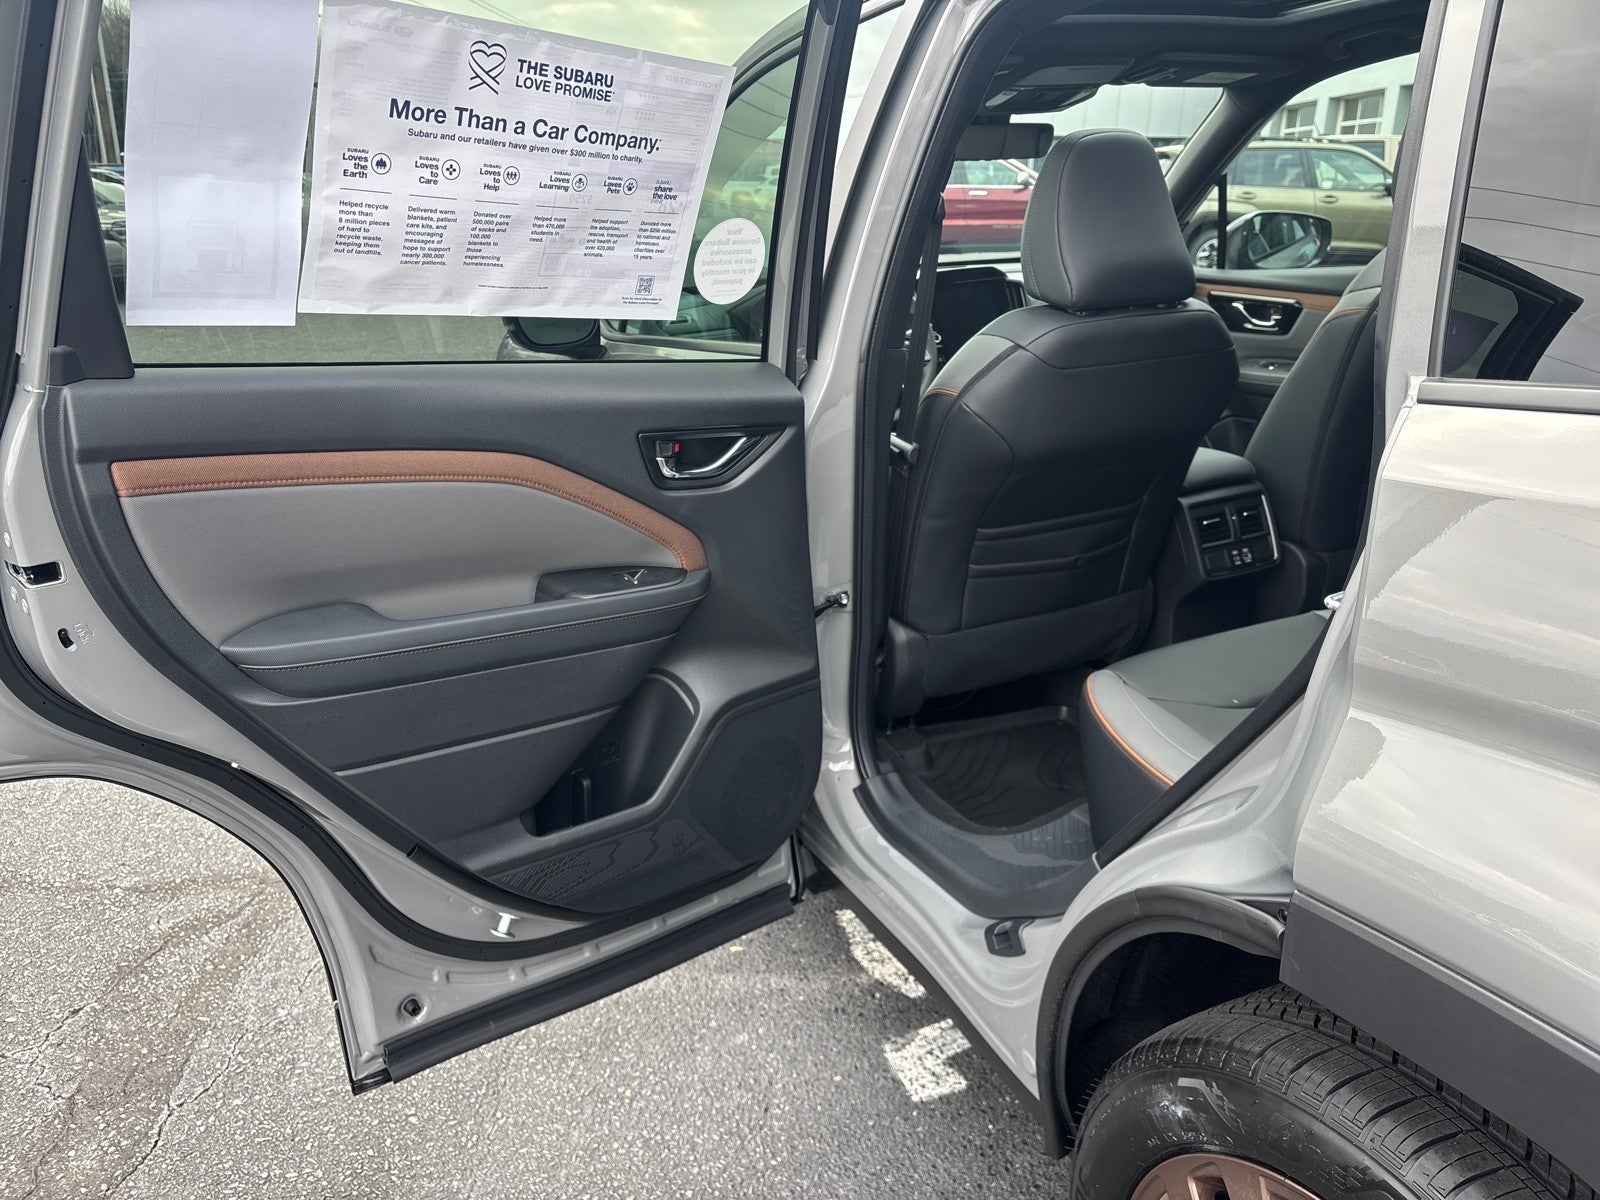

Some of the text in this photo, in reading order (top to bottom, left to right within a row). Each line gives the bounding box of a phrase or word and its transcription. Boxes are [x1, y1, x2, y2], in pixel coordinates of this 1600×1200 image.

[517, 58, 614, 88] THE SUBARU
[515, 75, 552, 93] LOVE
[388, 97, 660, 154] More Than a Car Company.
[407, 128, 644, 164] Subaru and our retailers have given over $300 million to charity.
[342, 152, 369, 162] Loves
[418, 155, 440, 163] SUBARU
[353, 162, 368, 171] the
[414, 160, 439, 171] Loves
[343, 169, 368, 179] Earth
[430, 170, 439, 178] to
[479, 168, 501, 177] Loves
[418, 176, 439, 186] Care
[549, 175, 570, 184] Loves
[603, 180, 622, 188] Loves
[483, 183, 500, 192] Help
[539, 181, 570, 192] Learning
[654, 185, 673, 193] share
[652, 192, 678, 201] the love
[339, 200, 363, 208] Helped
[408, 205, 438, 214] Delivered
[473, 210, 499, 218] Donated
[407, 214, 436, 222] blankets,
[404, 230, 444, 238] encouraging
[334, 240, 362, 248] keeping
[464, 254, 501, 262] experiencing
